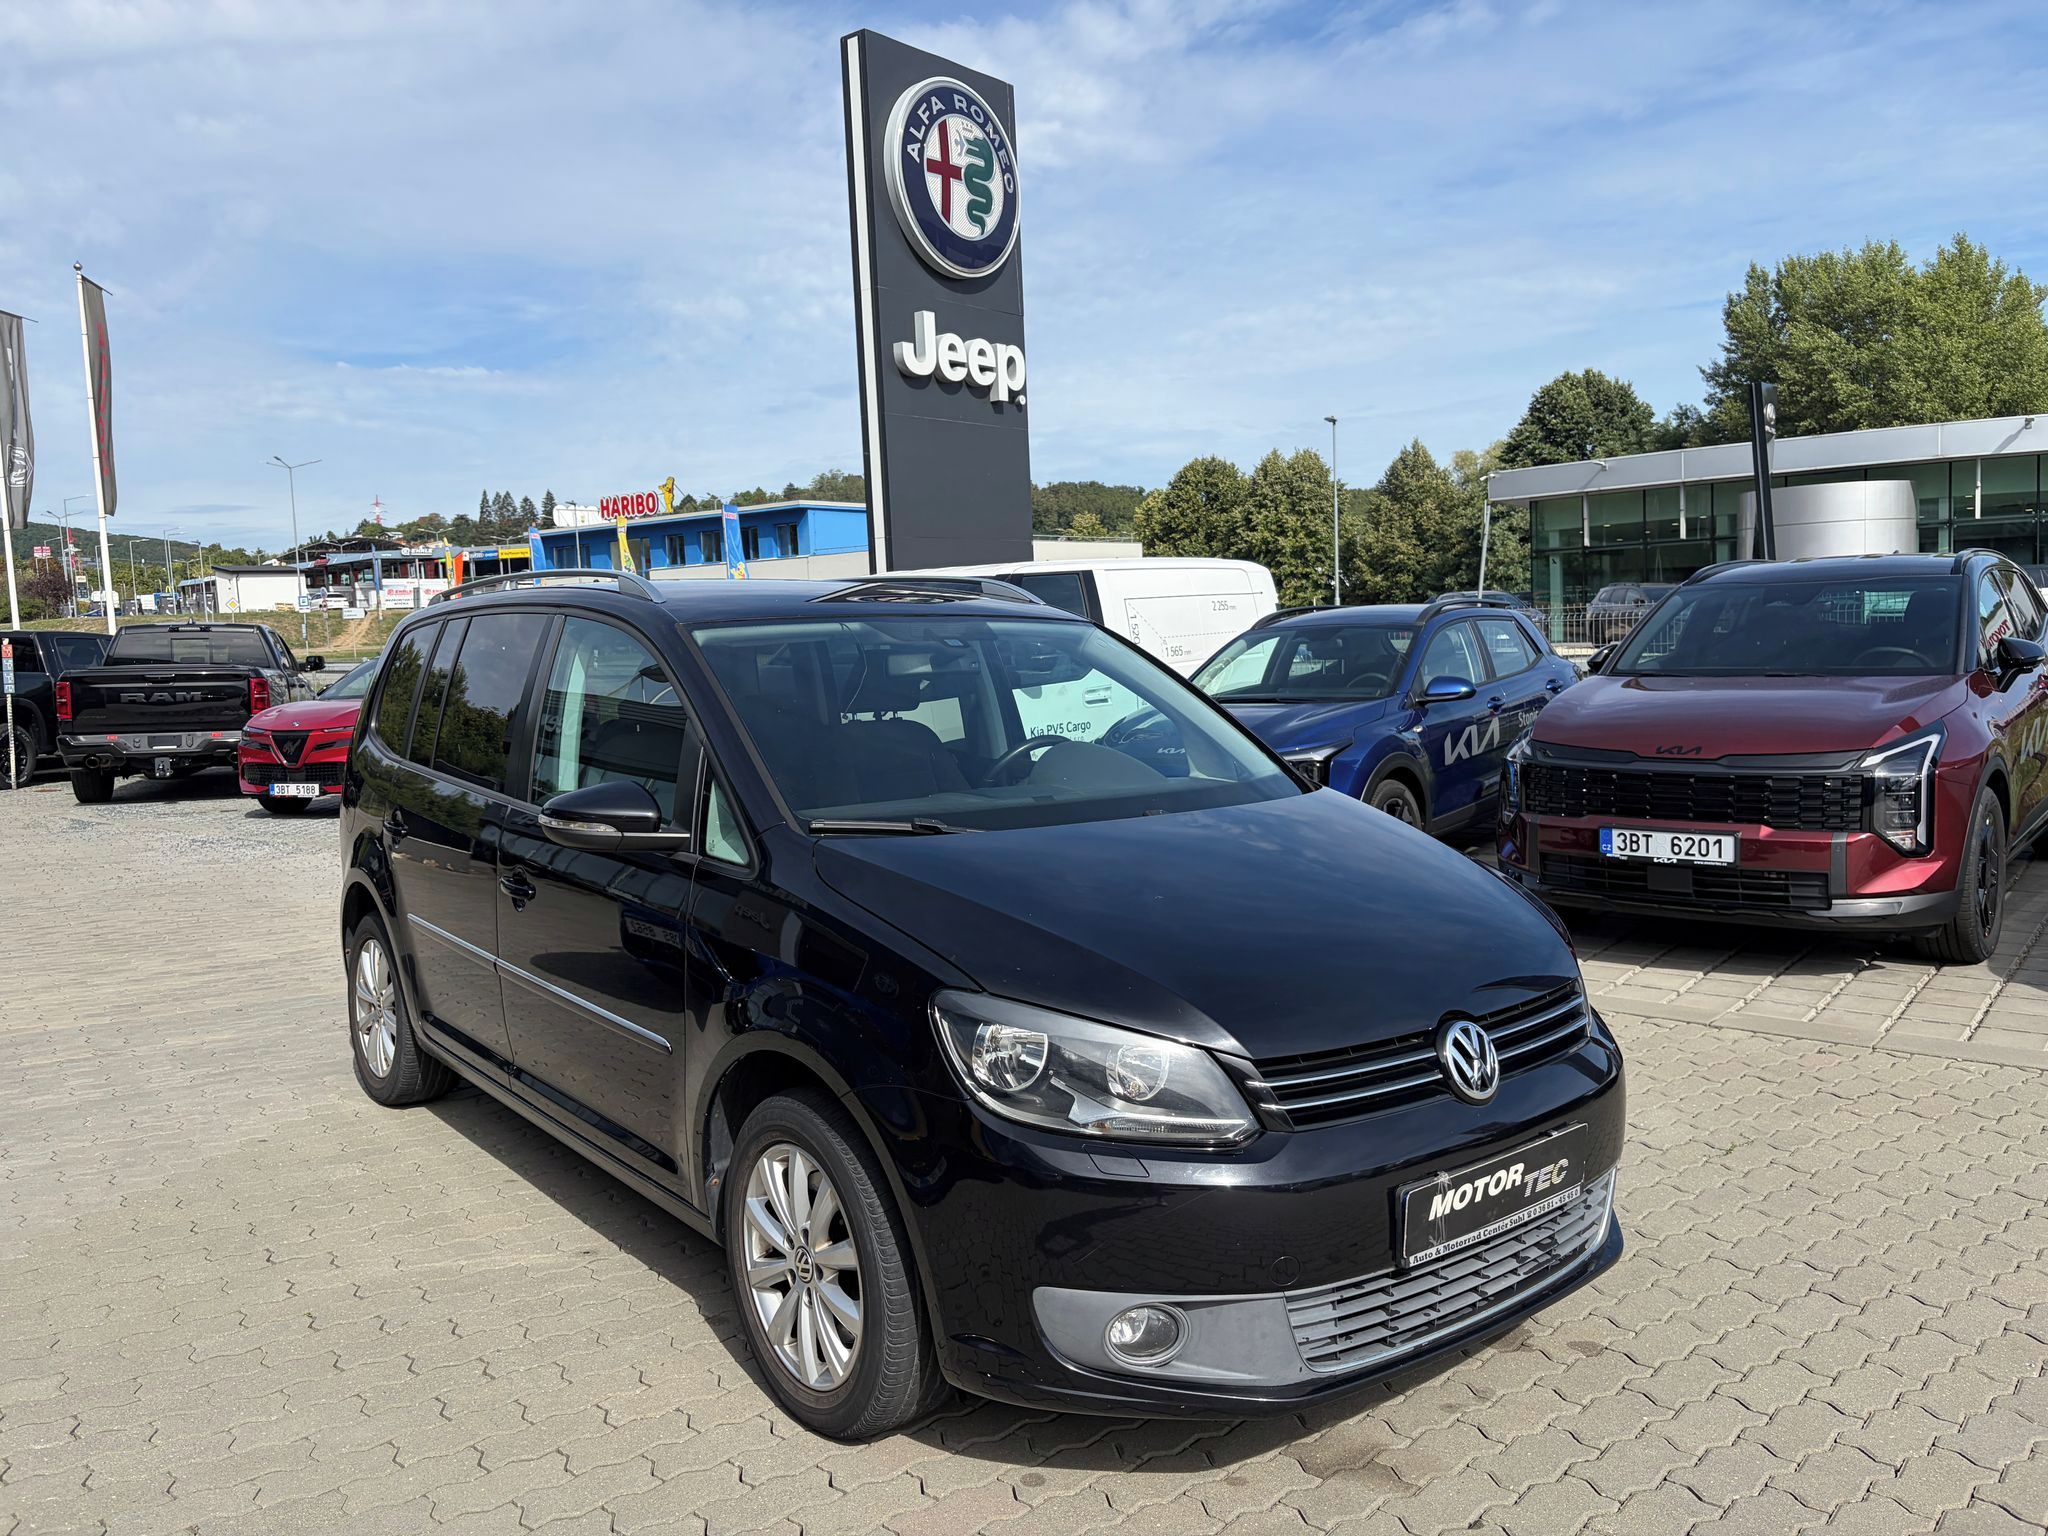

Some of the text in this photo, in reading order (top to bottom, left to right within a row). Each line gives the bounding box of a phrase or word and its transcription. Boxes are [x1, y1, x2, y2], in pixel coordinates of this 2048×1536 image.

[907, 94, 1014, 194] ALFA ROMEO
[893, 310, 1024, 402] Jeep
[600, 491, 658, 519] HARIBO
[119, 692, 202, 703] RAM
[1030, 720, 1092, 738] Kia PV5 Cargo
[1444, 716, 1500, 766] KIA
[275, 785, 316, 795] 3BT 5188
[1617, 832, 1723, 858] 3BT 6201
[1412, 1251, 1434, 1264] Auto
[1434, 1247, 1442, 1256] &
[1443, 1231, 1482, 1252] Motorrad
[1483, 1222, 1509, 1237] Center
[1509, 1213, 1525, 1227] Suhl
